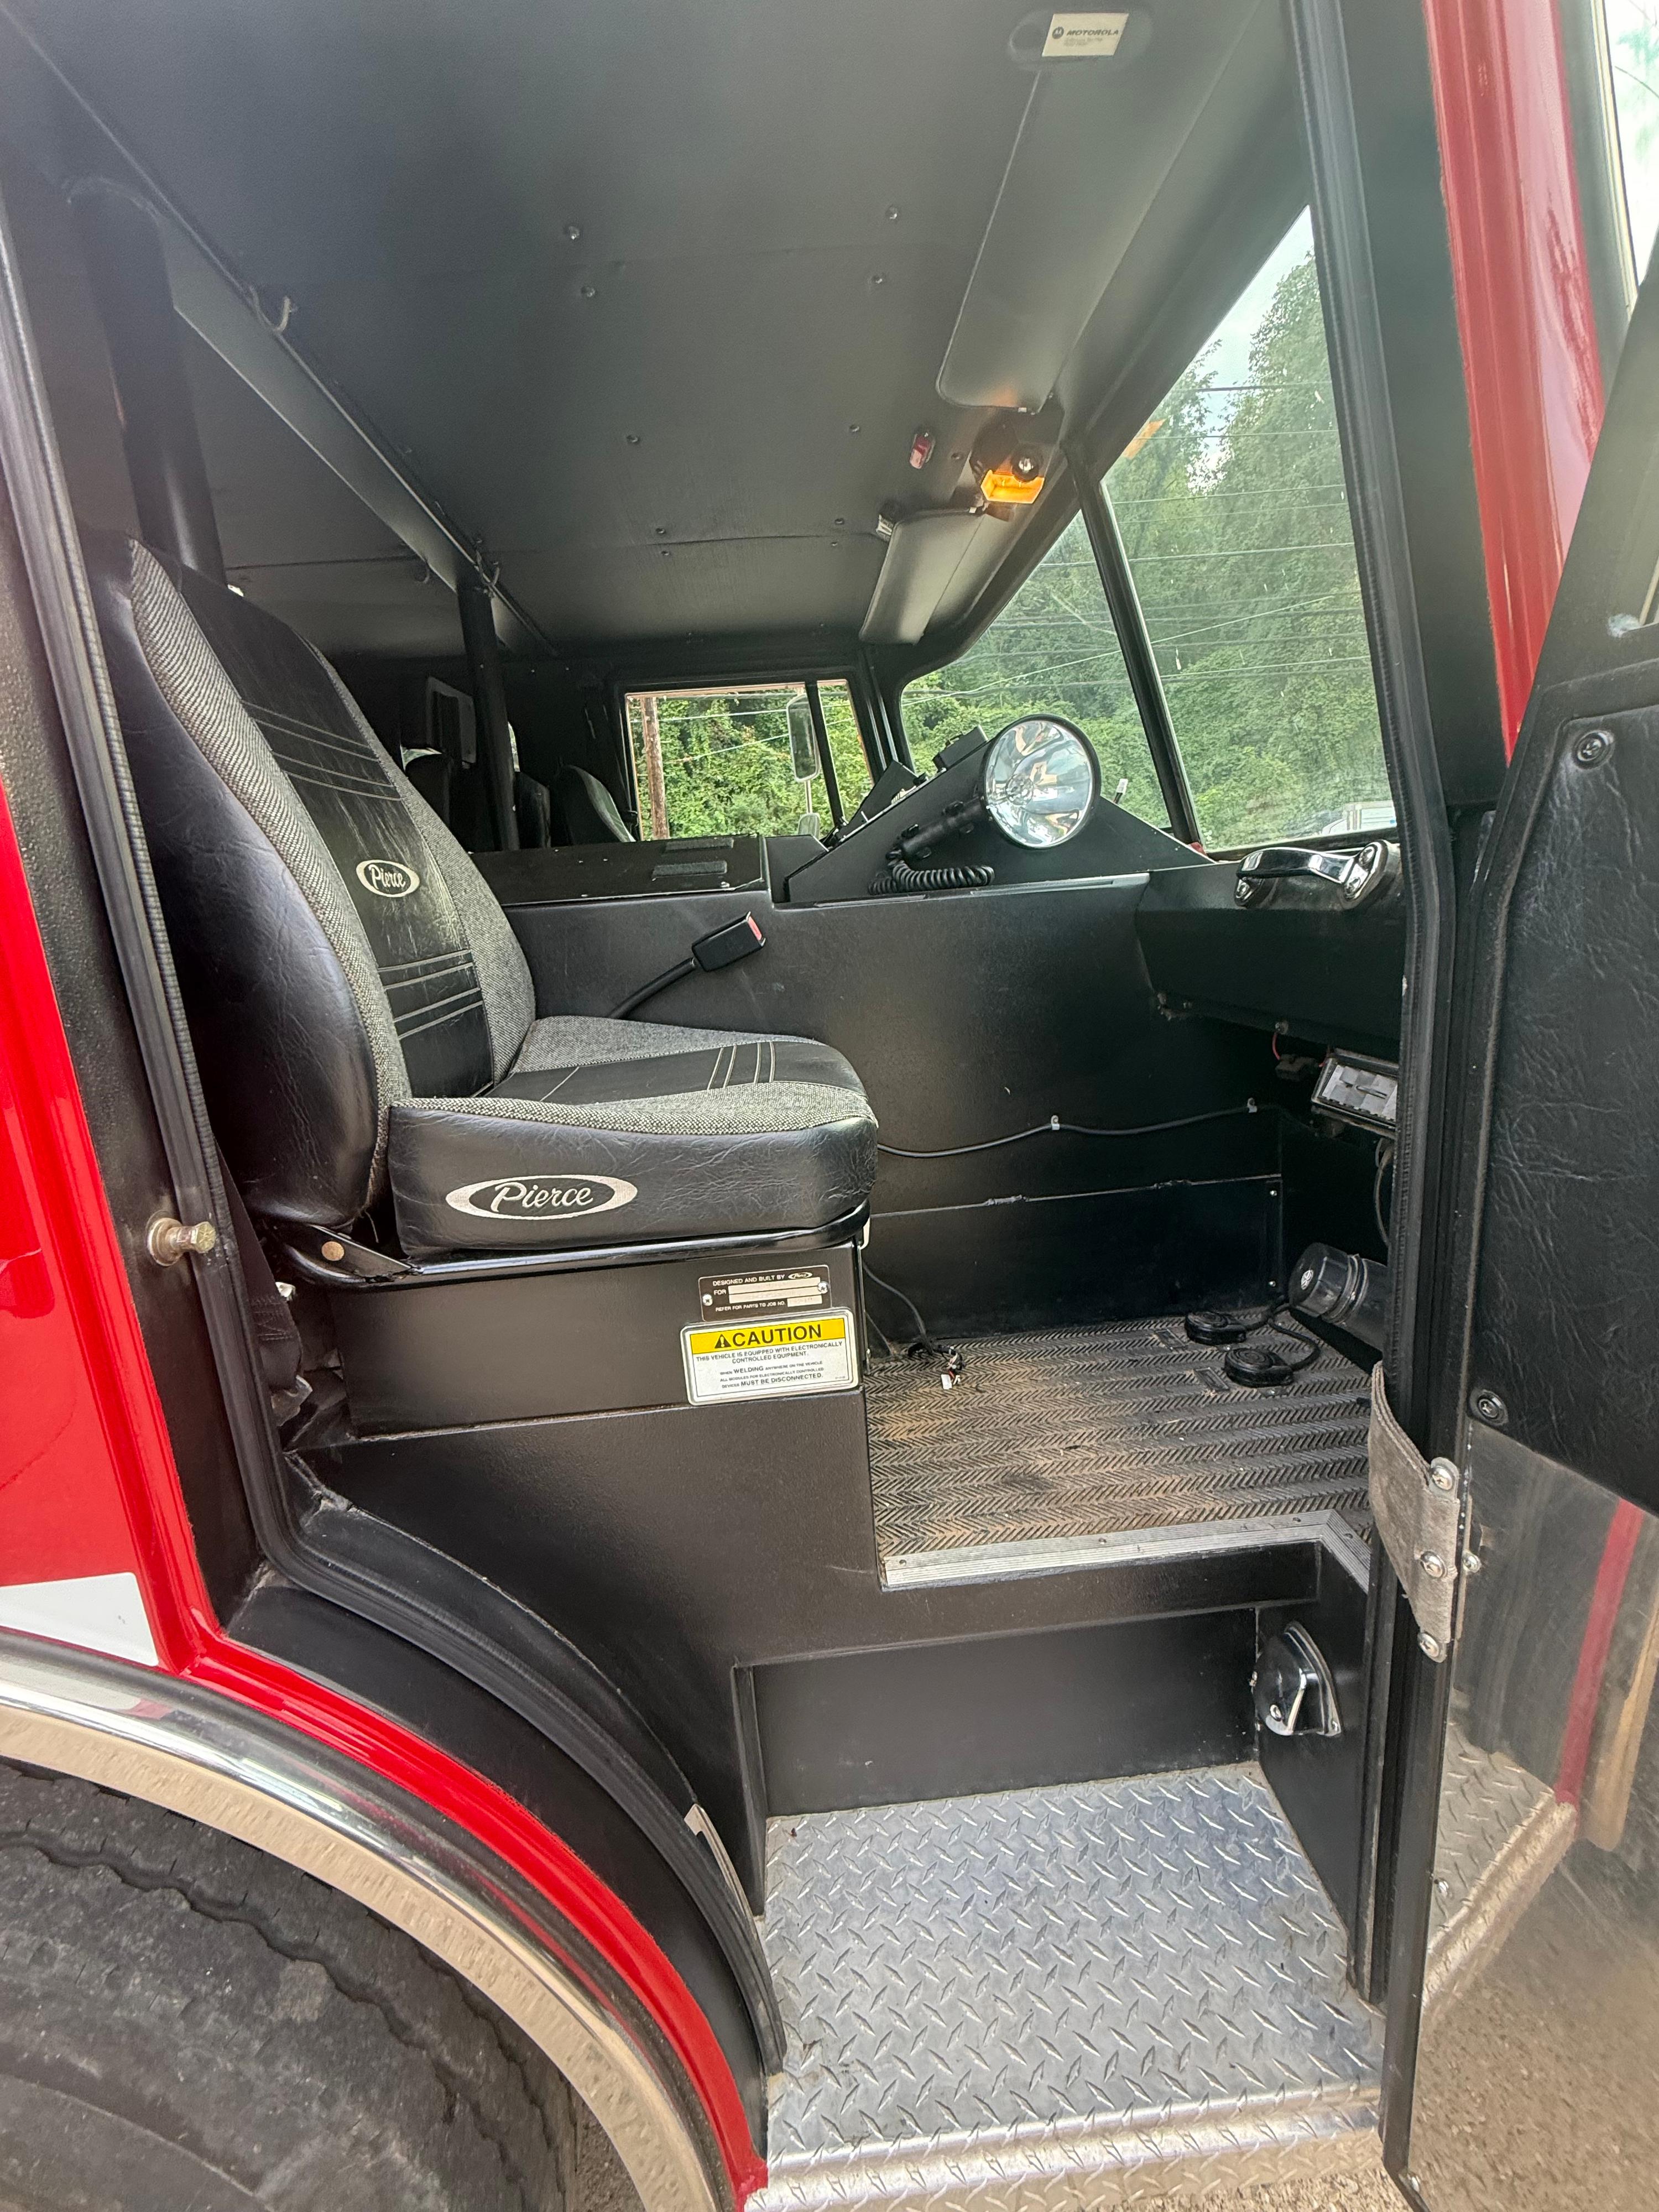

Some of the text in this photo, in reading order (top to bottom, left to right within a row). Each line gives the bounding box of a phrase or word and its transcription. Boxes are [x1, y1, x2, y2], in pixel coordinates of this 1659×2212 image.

[368, 864, 406, 890] Pierce
[491, 1181, 593, 1212] Pierce
[732, 1324, 822, 1347] CAUTION
[791, 1341, 842, 1352] ELECTRONICALLY
[732, 1351, 809, 1364] CONTROLLED EQUIPMENT.
[733, 1365, 764, 1374] WELDING
[771, 1373, 823, 1383] DISCONNECTED.
